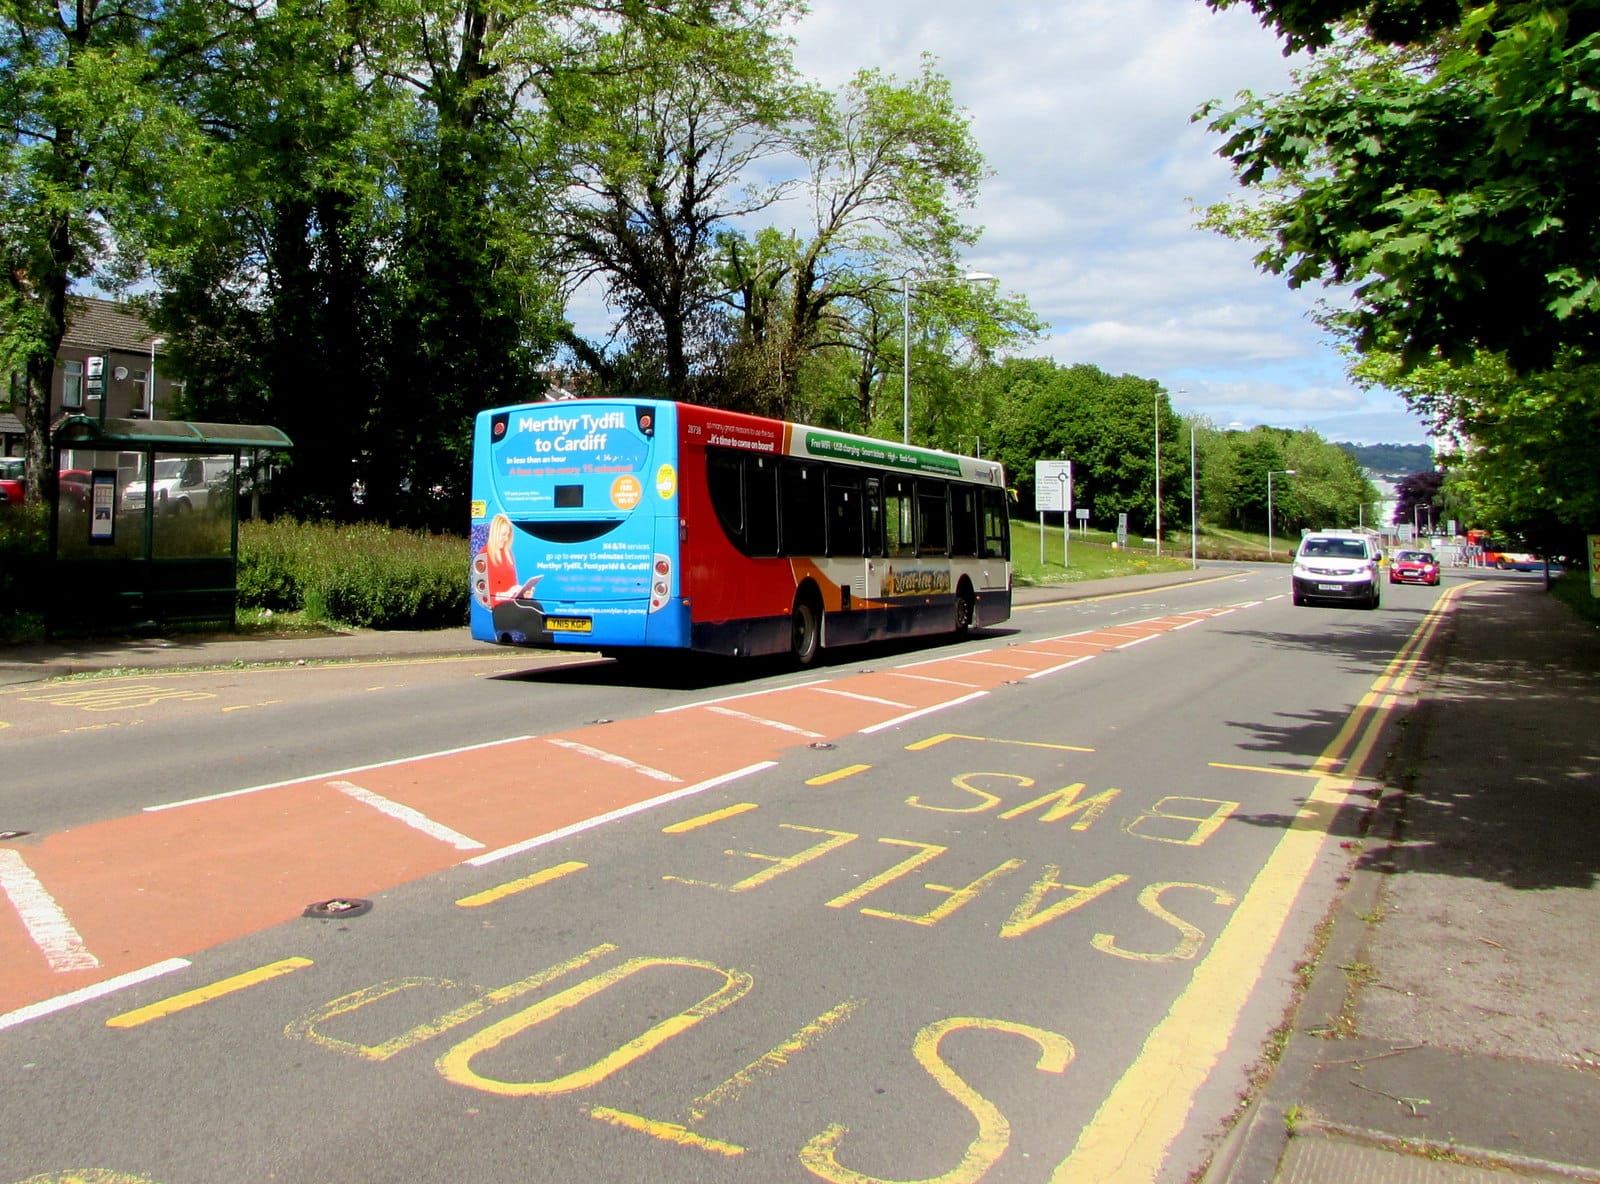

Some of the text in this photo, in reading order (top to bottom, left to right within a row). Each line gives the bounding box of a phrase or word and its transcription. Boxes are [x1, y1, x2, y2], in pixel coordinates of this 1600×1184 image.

[519, 412, 625, 435] Merthyr Tydfil
[535, 434, 607, 452] to Cardiff
[506, 456, 513, 465] in
[514, 456, 526, 464] less
[526, 455, 541, 464] than
[550, 455, 566, 463] hour
[569, 553, 588, 561] every
[597, 552, 624, 560] minutes
[627, 562, 650, 570] Cardiff
